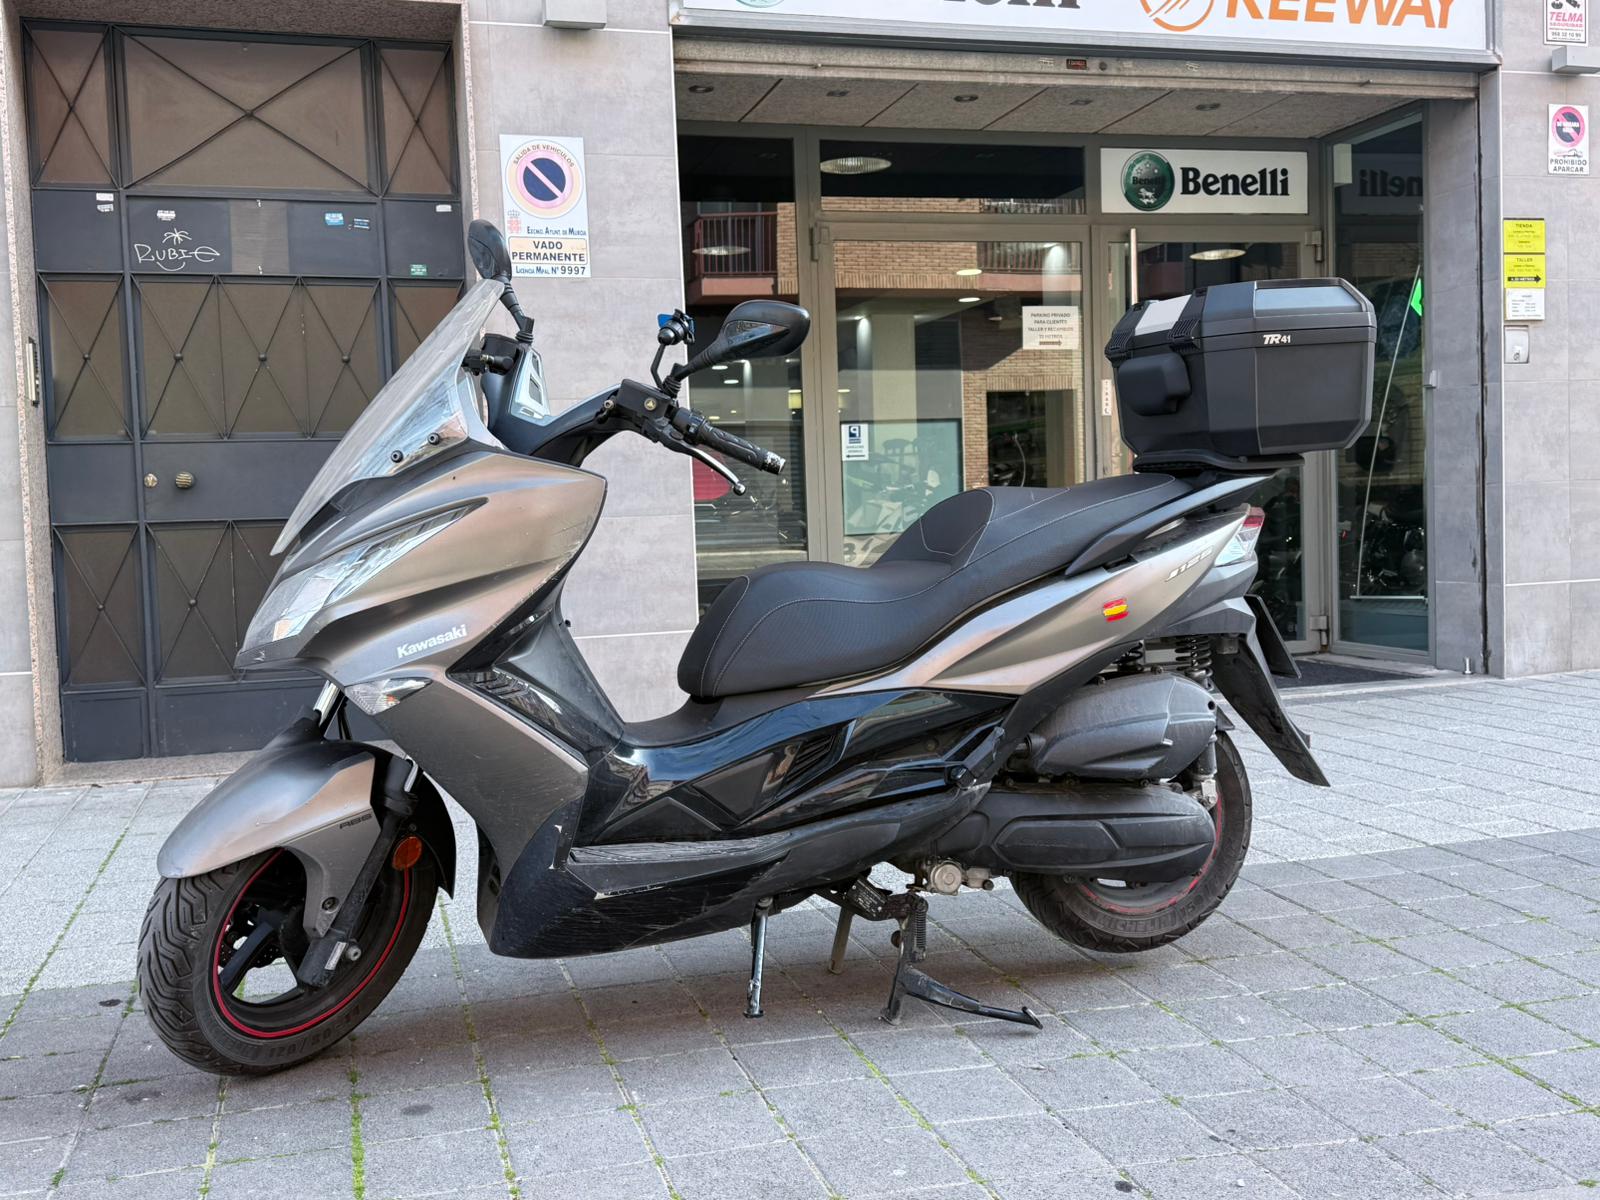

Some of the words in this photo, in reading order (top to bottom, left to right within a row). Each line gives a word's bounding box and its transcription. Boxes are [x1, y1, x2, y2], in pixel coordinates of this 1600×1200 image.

[1550, 11, 1583, 22] TELMA
[513, 147, 531, 164] SALIDA
[1550, 158, 1587, 166] PROHIBIDO
[1180, 167, 1290, 196] Benelli
[533, 241, 563, 249] VADO
[511, 252, 586, 261] PERMANENTE
[560, 266, 586, 275] 9997
[397, 624, 467, 658] Kawasaki
